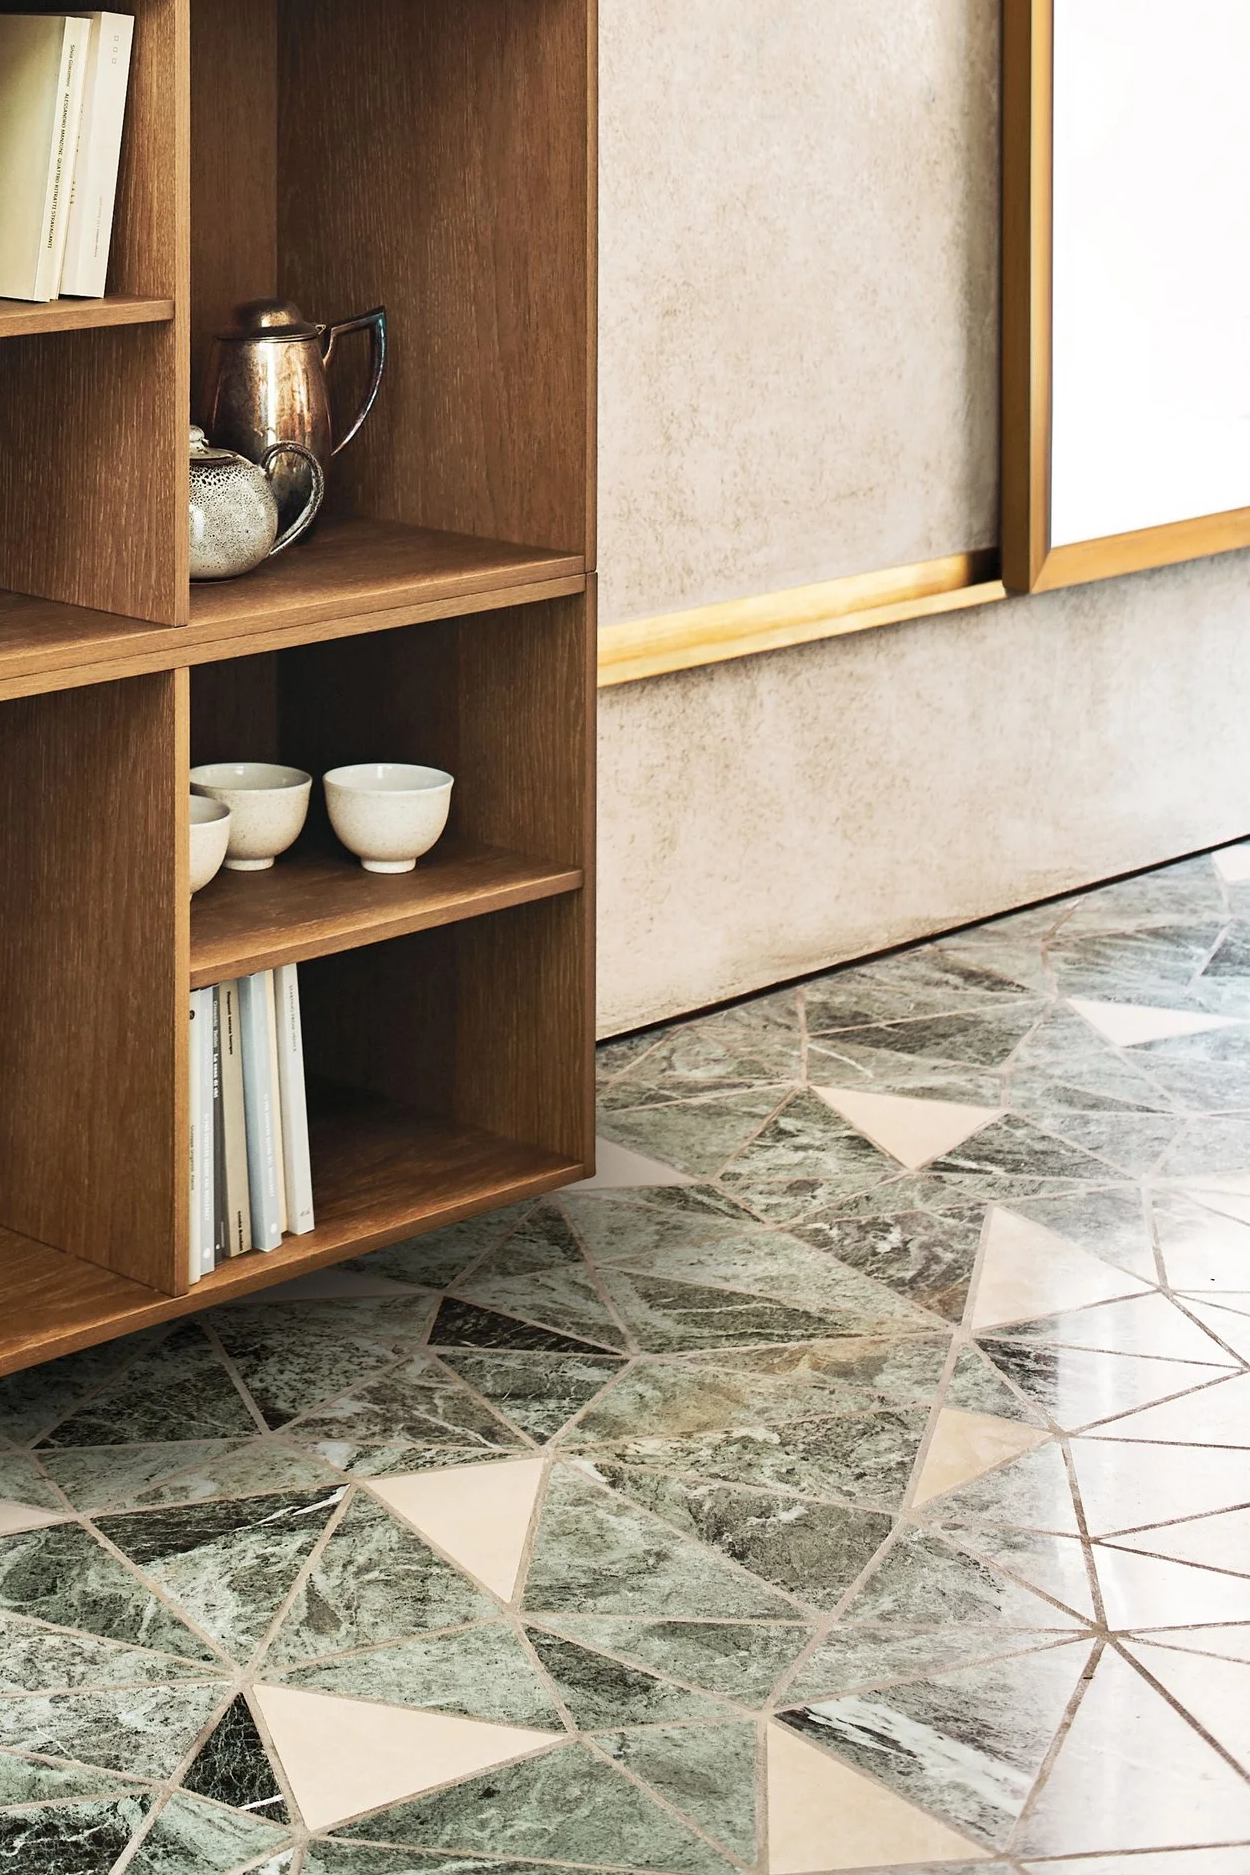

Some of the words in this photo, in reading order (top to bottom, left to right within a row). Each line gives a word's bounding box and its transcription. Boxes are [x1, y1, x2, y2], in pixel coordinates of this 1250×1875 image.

[61, 92, 70, 129] ALESSANDRO
[54, 157, 63, 184] QUATTRO
[51, 184, 59, 210] RITRATTI
[47, 210, 56, 249] STRAVAGANTI
